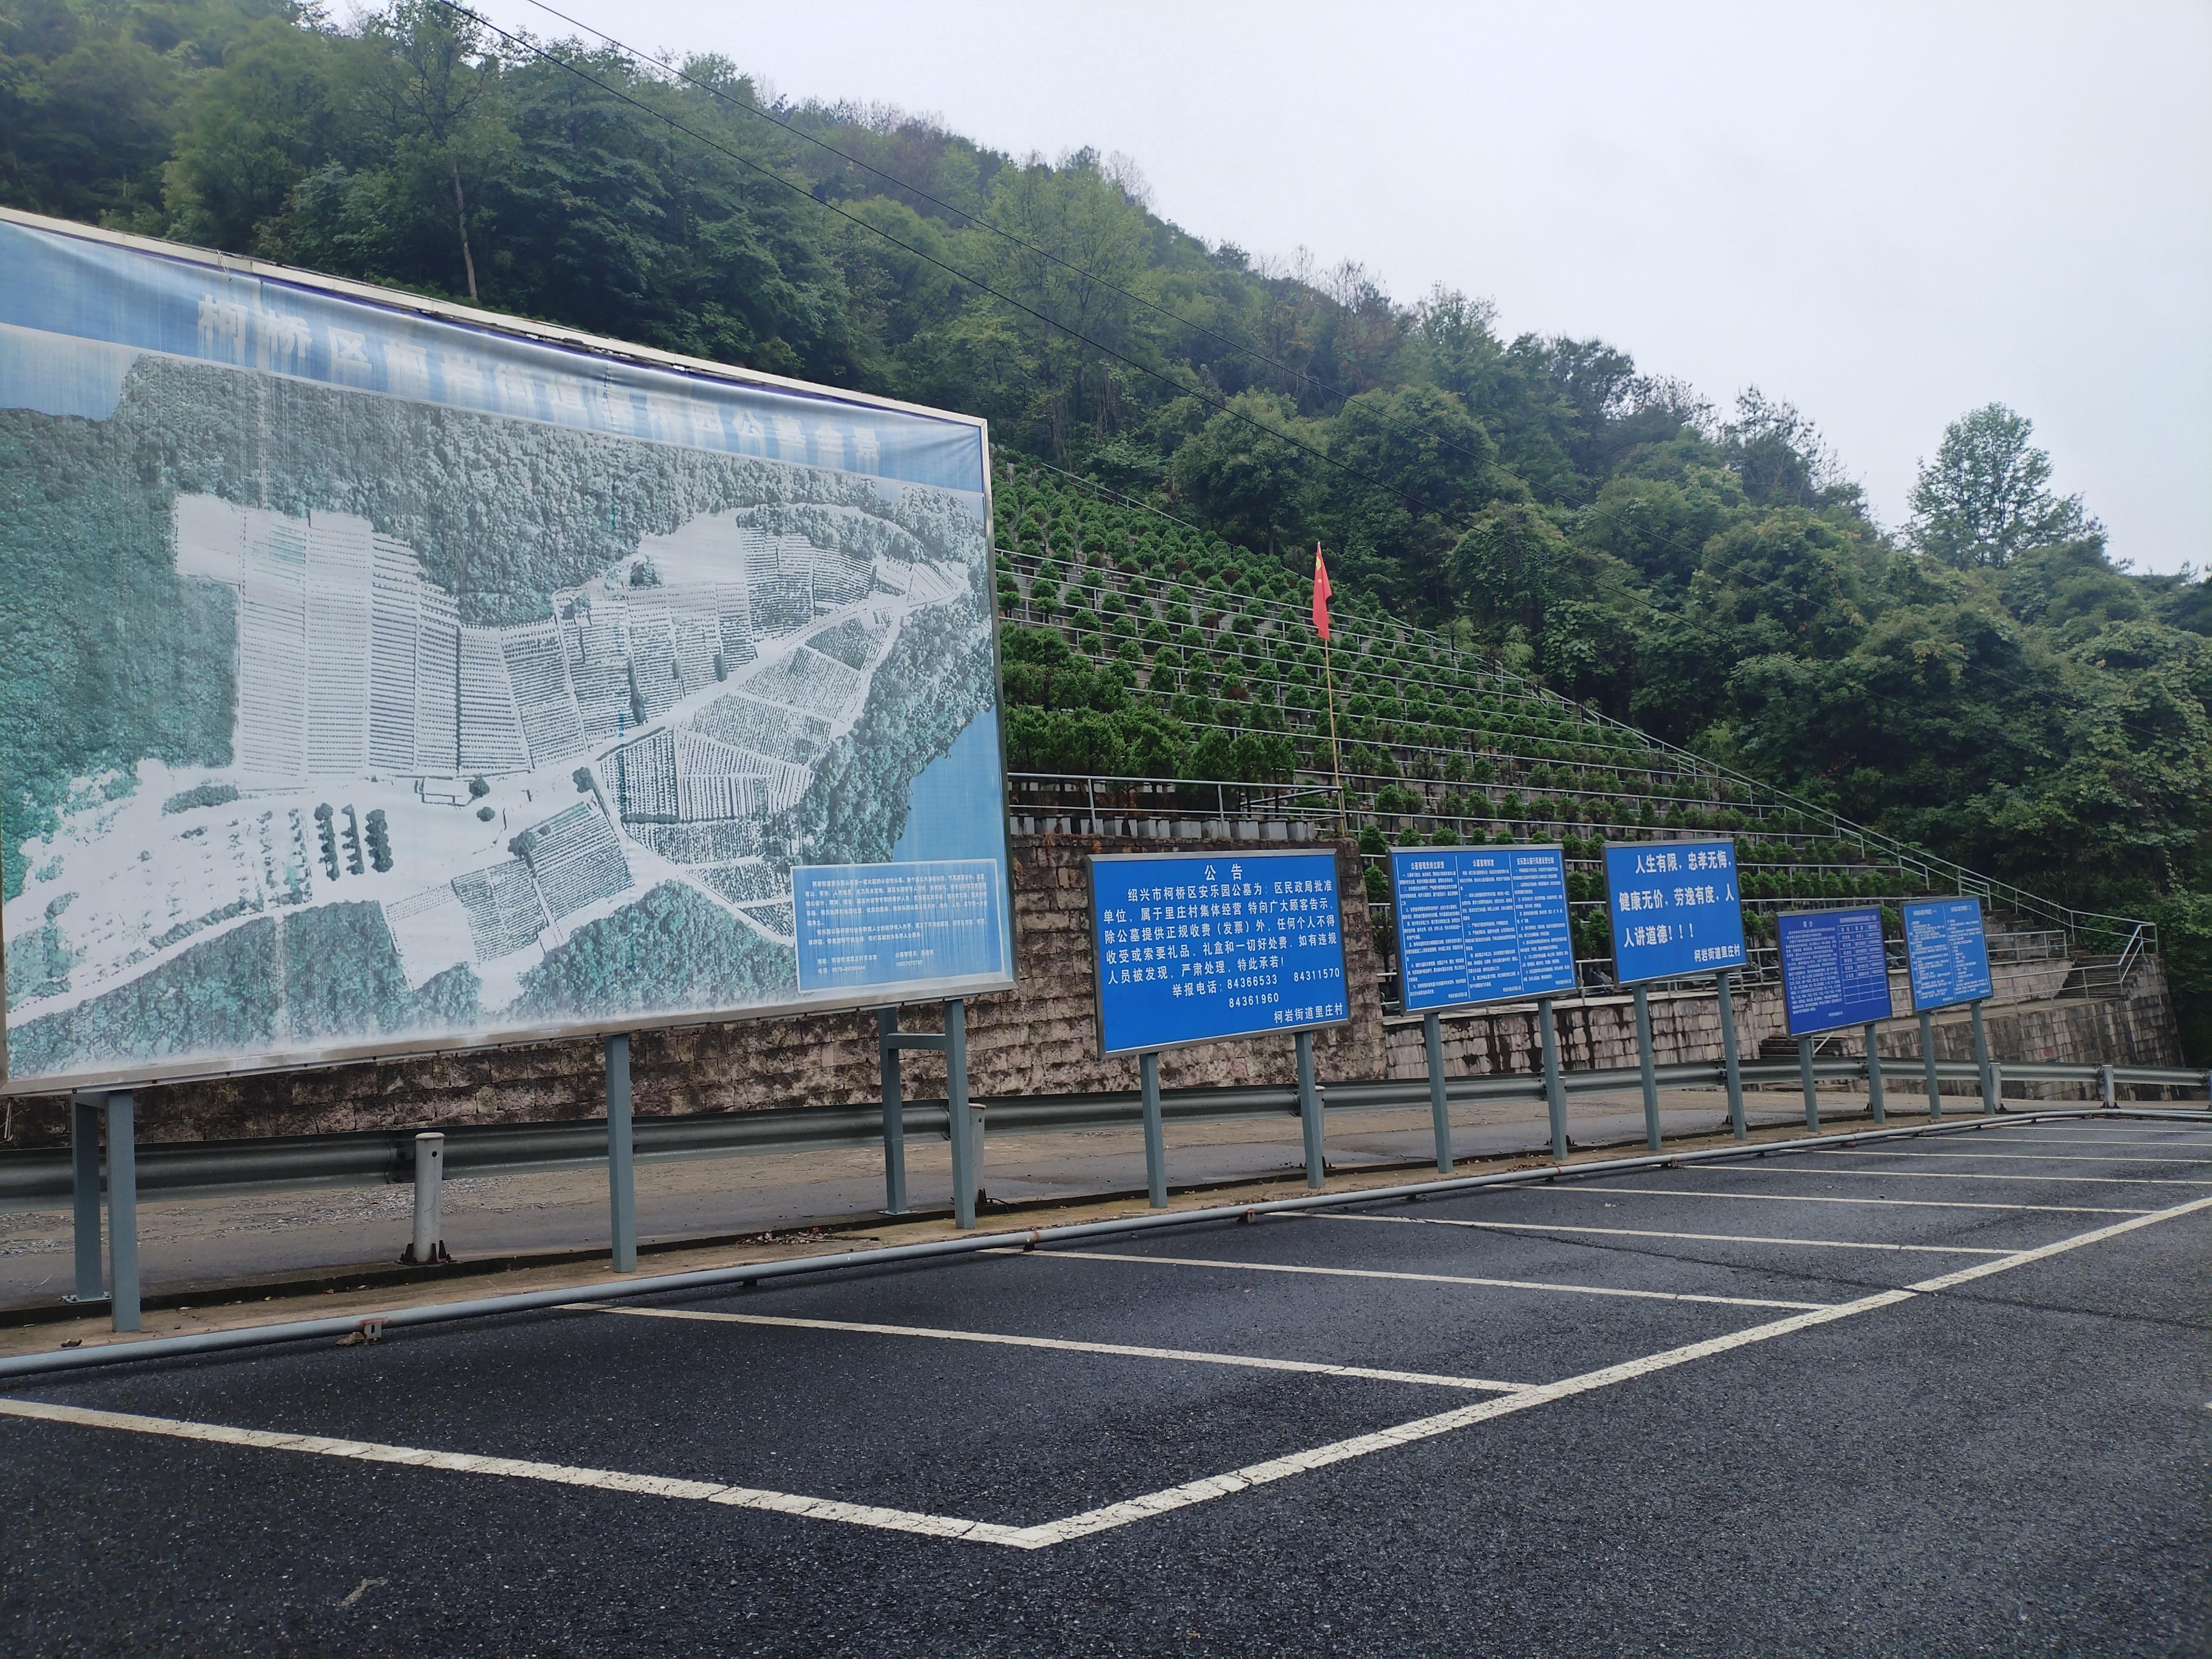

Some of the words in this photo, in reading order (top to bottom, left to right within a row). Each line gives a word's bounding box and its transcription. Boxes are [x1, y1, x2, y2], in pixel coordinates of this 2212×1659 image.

[1204, 864, 1243, 881] 公告
[1694, 943, 1741, 962] 柯岩街道里庄村
[1293, 967, 1340, 983] 84311570
[1229, 992, 1279, 1009] 84361960
[1273, 1002, 1343, 1023] 柯岩街道里庄村
